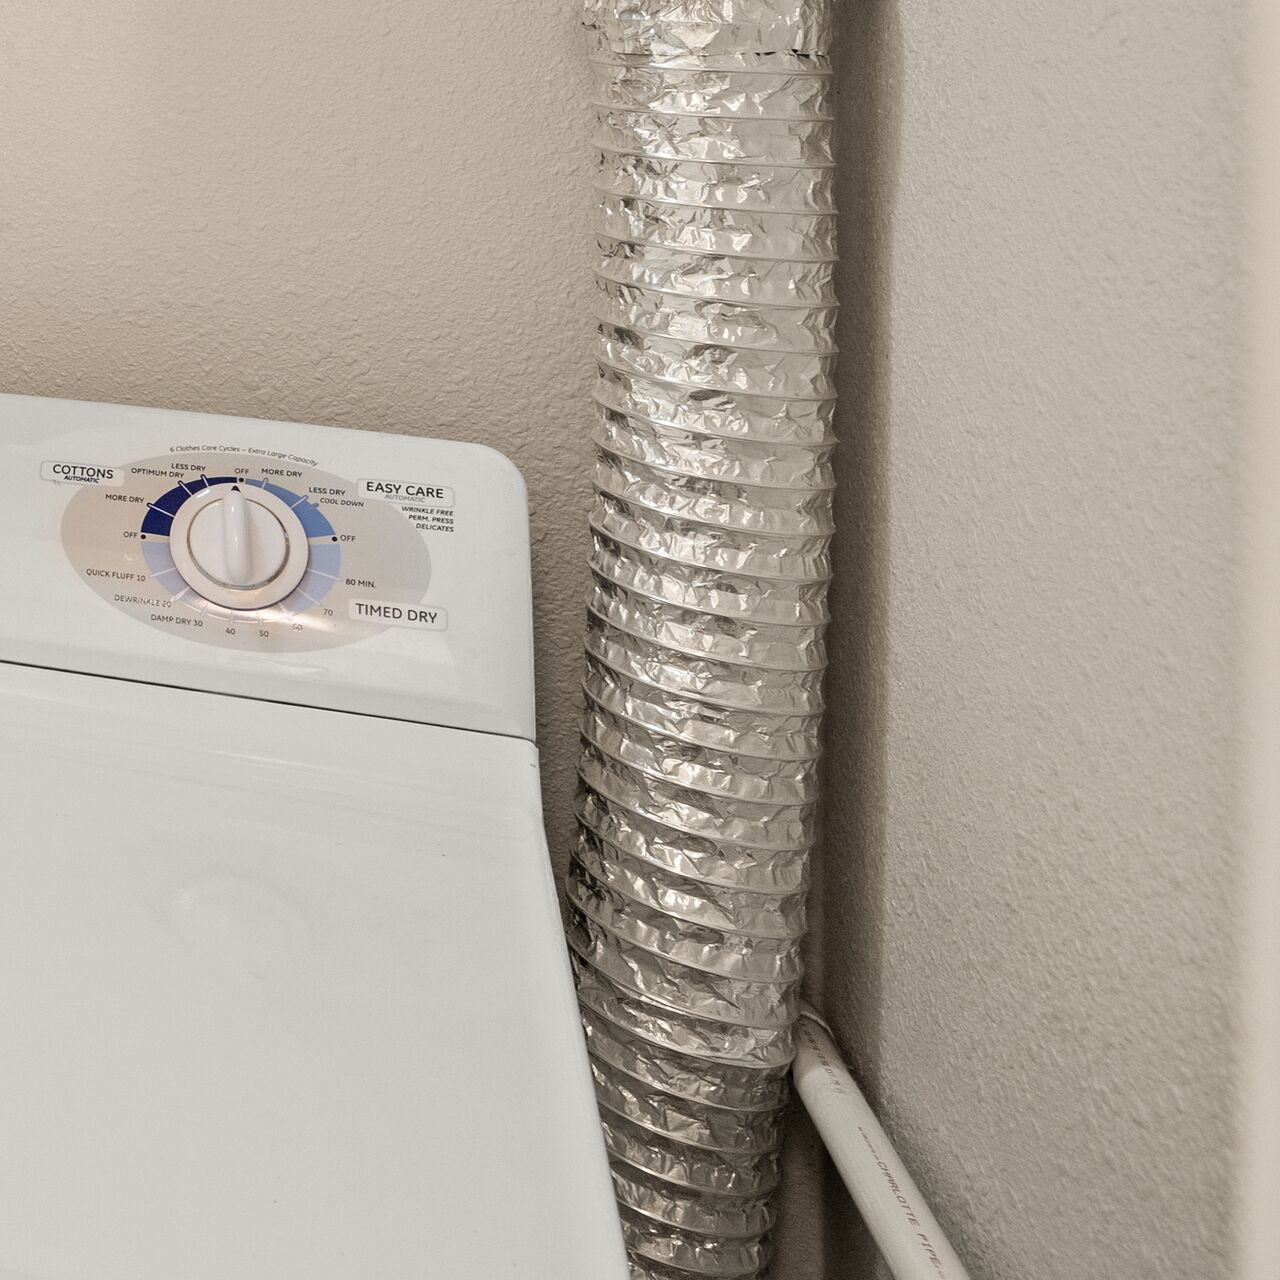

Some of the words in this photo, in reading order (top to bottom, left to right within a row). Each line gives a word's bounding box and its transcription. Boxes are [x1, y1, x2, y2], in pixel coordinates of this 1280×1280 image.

[218, 445, 240, 453] Cycles
[267, 450, 287, 459] Large
[288, 453, 319, 467] Capacity
[52, 463, 114, 480] COTTONS
[131, 467, 167, 477] OPTIMUM
[169, 470, 185, 478] DRY
[171, 463, 189, 471] LESS
[190, 464, 207, 472] DRY
[234, 467, 249, 475] OFF
[261, 468, 285, 476] MORE
[286, 470, 303, 478] DRY
[63, 475, 100, 483] AUTOMATIC
[309, 487, 327, 495] LESS
[329, 488, 346, 496] DRY
[366, 481, 402, 494] EASY
[405, 485, 444, 499] CARE
[105, 493, 127, 502] MORE
[320, 497, 339, 505] COOL
[340, 500, 364, 508] DOWN
[384, 493, 426, 503] AUTOMATIC
[401, 505, 434, 515] WRINKLE
[436, 508, 454, 517] FREE
[408, 514, 430, 522] PERM.
[432, 516, 454, 525] PRESS
[415, 522, 454, 533] DELICATES
[86, 568, 111, 578] QUICK
[112, 571, 135, 581] FLUFF
[345, 578, 356, 586] 80
[357, 580, 377, 589] MIN.
[114, 594, 160, 607] DEWRINKLE
[161, 600, 172, 608] 20
[323, 608, 333, 616] 70
[355, 603, 403, 619] TIMED
[407, 610, 438, 624] DRY
[150, 613, 174, 623] DAMP
[175, 617, 192, 625] DRY
[193, 619, 203, 627] 30
[259, 630, 269, 638] 50
[878, 1161, 919, 1226] CHARLOTTE
